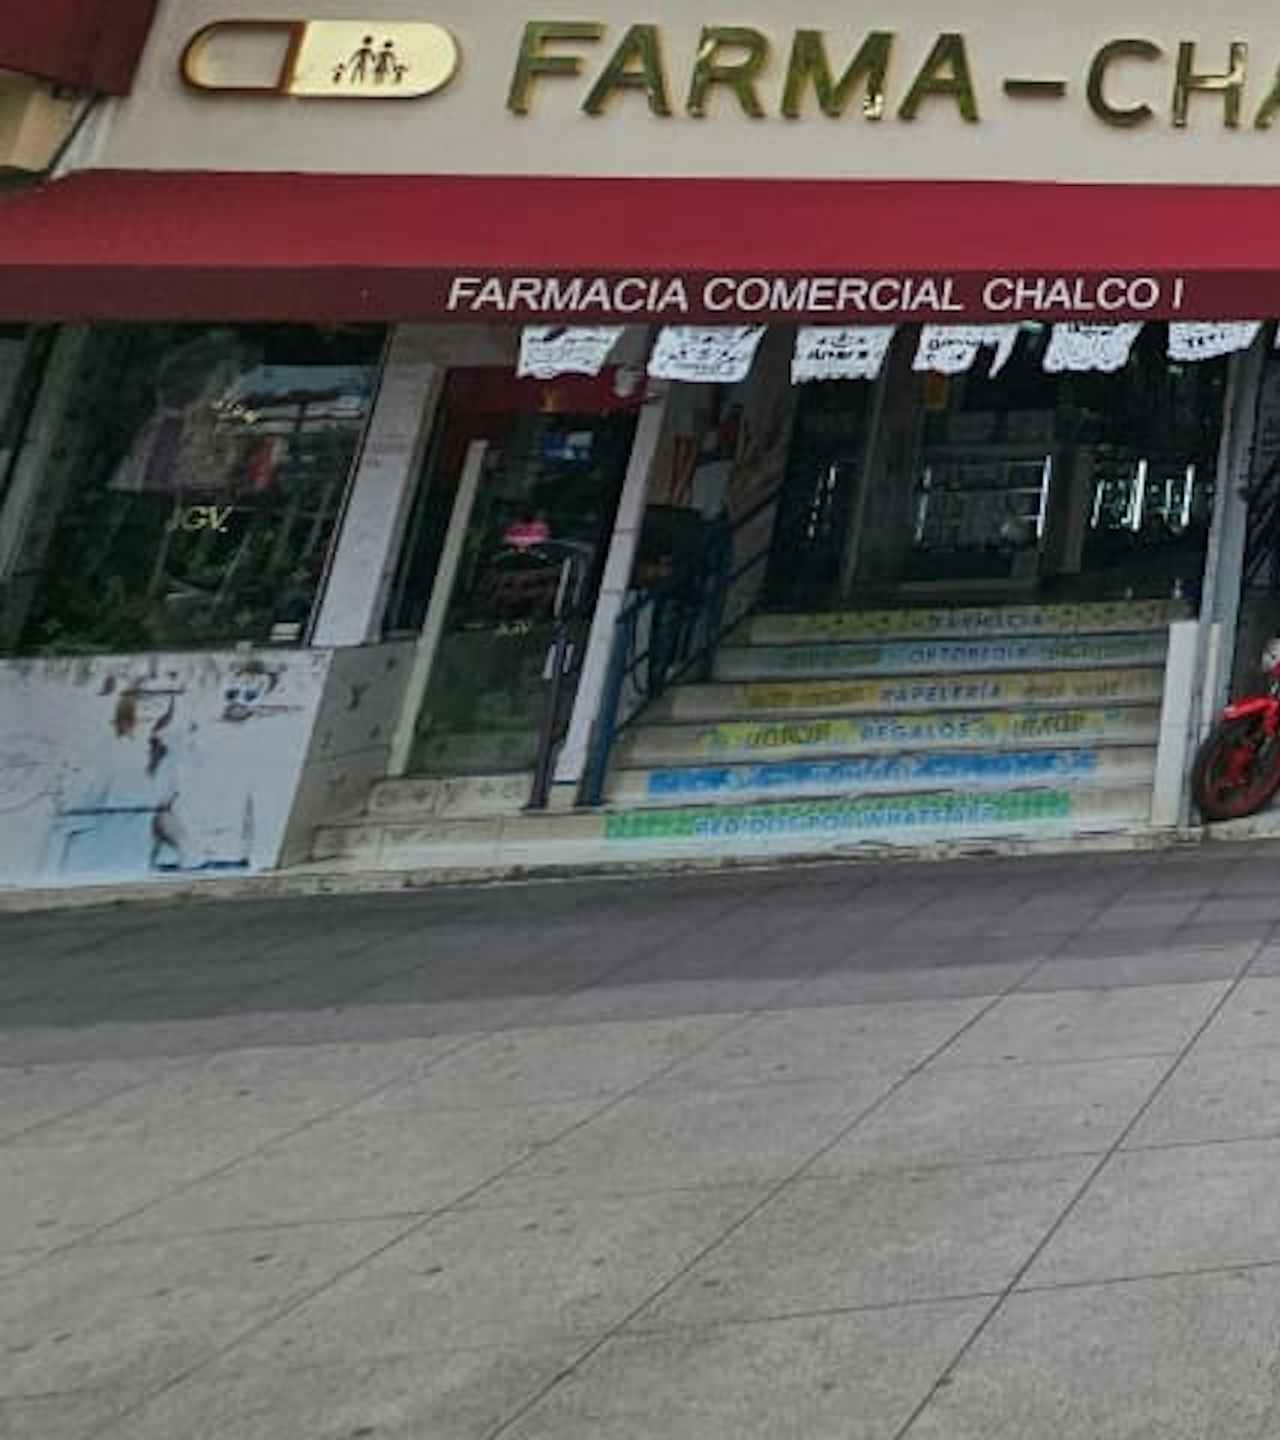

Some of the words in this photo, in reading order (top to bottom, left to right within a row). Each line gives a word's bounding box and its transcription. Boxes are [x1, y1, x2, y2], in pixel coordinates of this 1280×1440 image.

[446, 276, 689, 313] FARMACIA
[702, 276, 963, 312] COMERCIAL
[983, 276, 1160, 311] CHALCO
